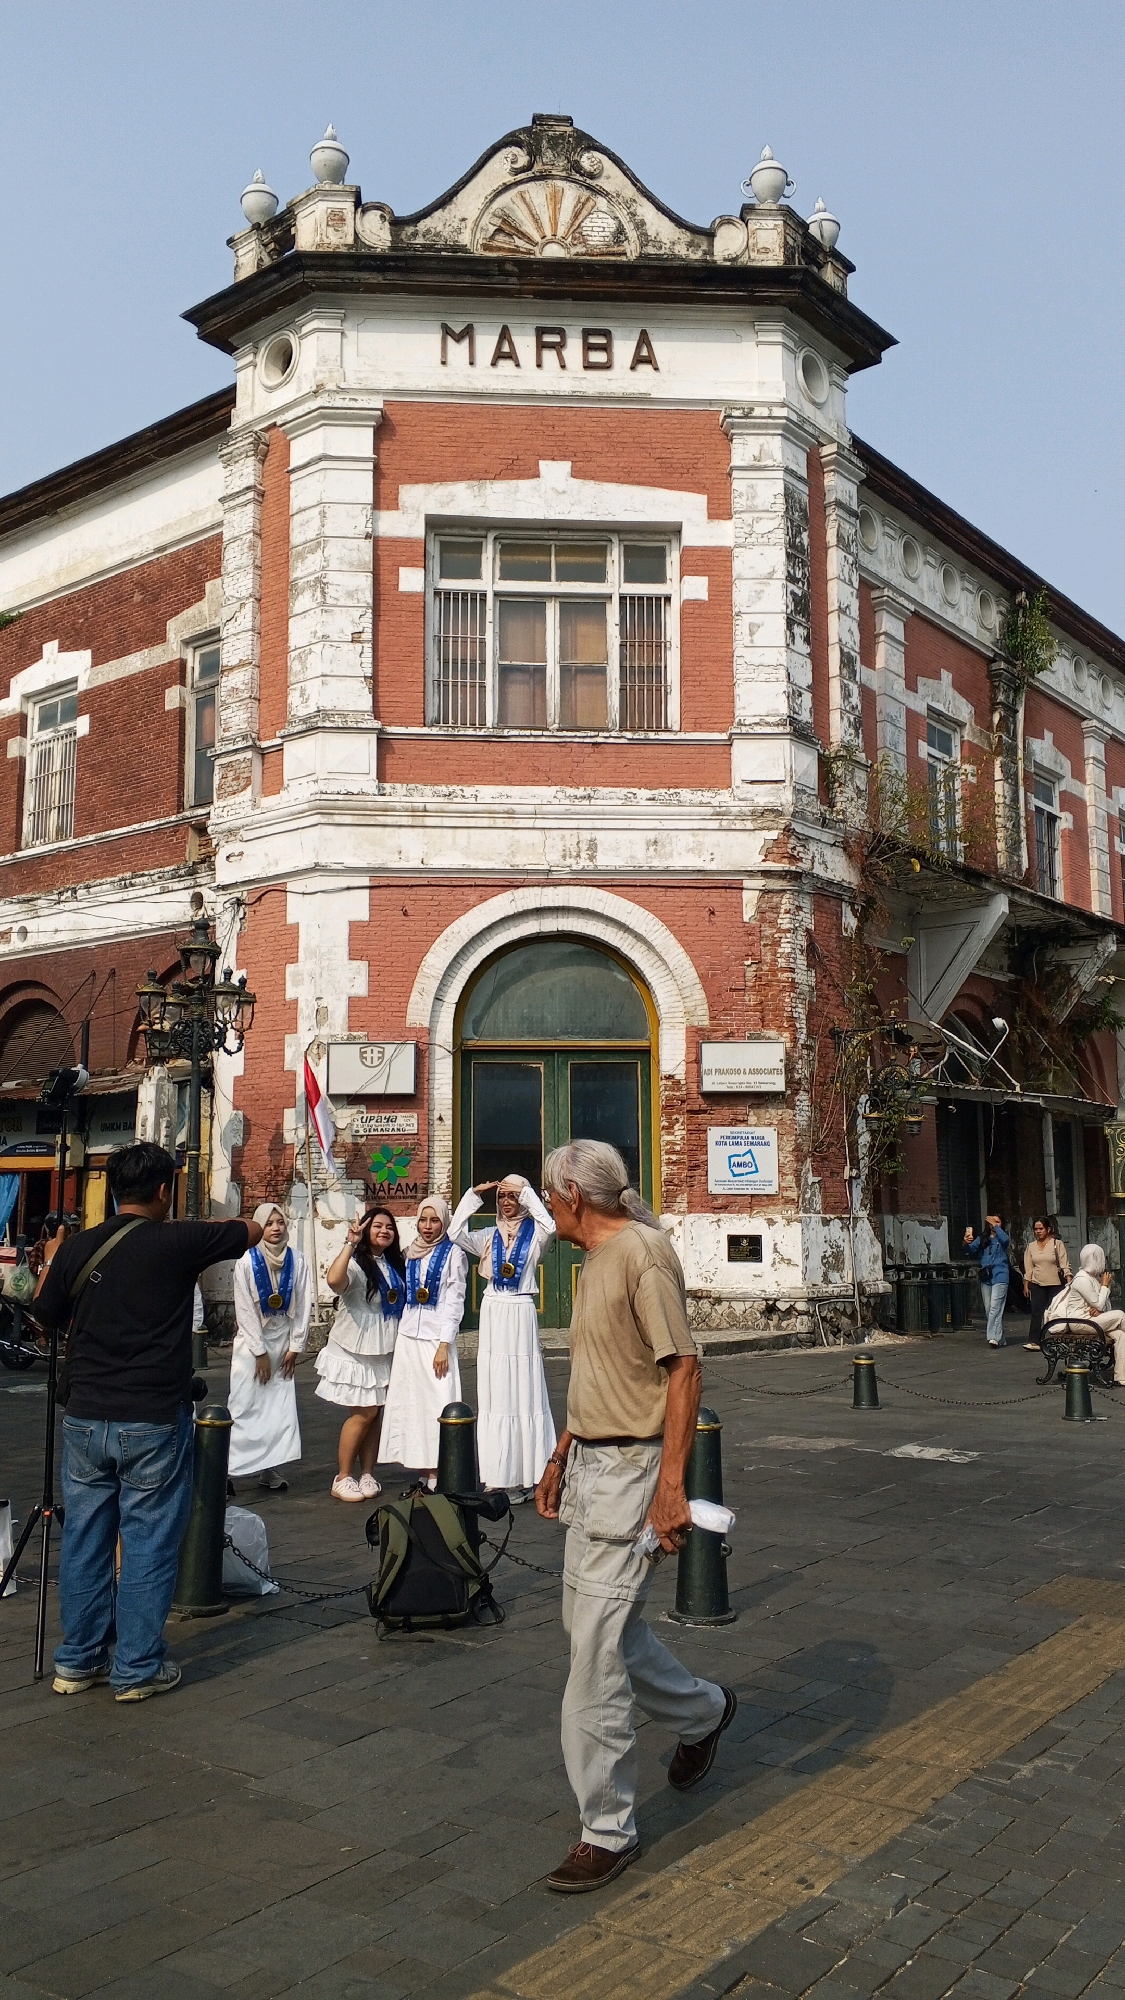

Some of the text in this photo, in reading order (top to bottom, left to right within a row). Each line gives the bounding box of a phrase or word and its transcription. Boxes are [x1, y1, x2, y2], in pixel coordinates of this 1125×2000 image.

[441, 322, 660, 372] MARBA
[703, 1067, 783, 1076] ADI PRAKOSO & ASSOCIATES
[100, 1122, 121, 1131] UMKM
[365, 1182, 418, 1195] NAFAM
